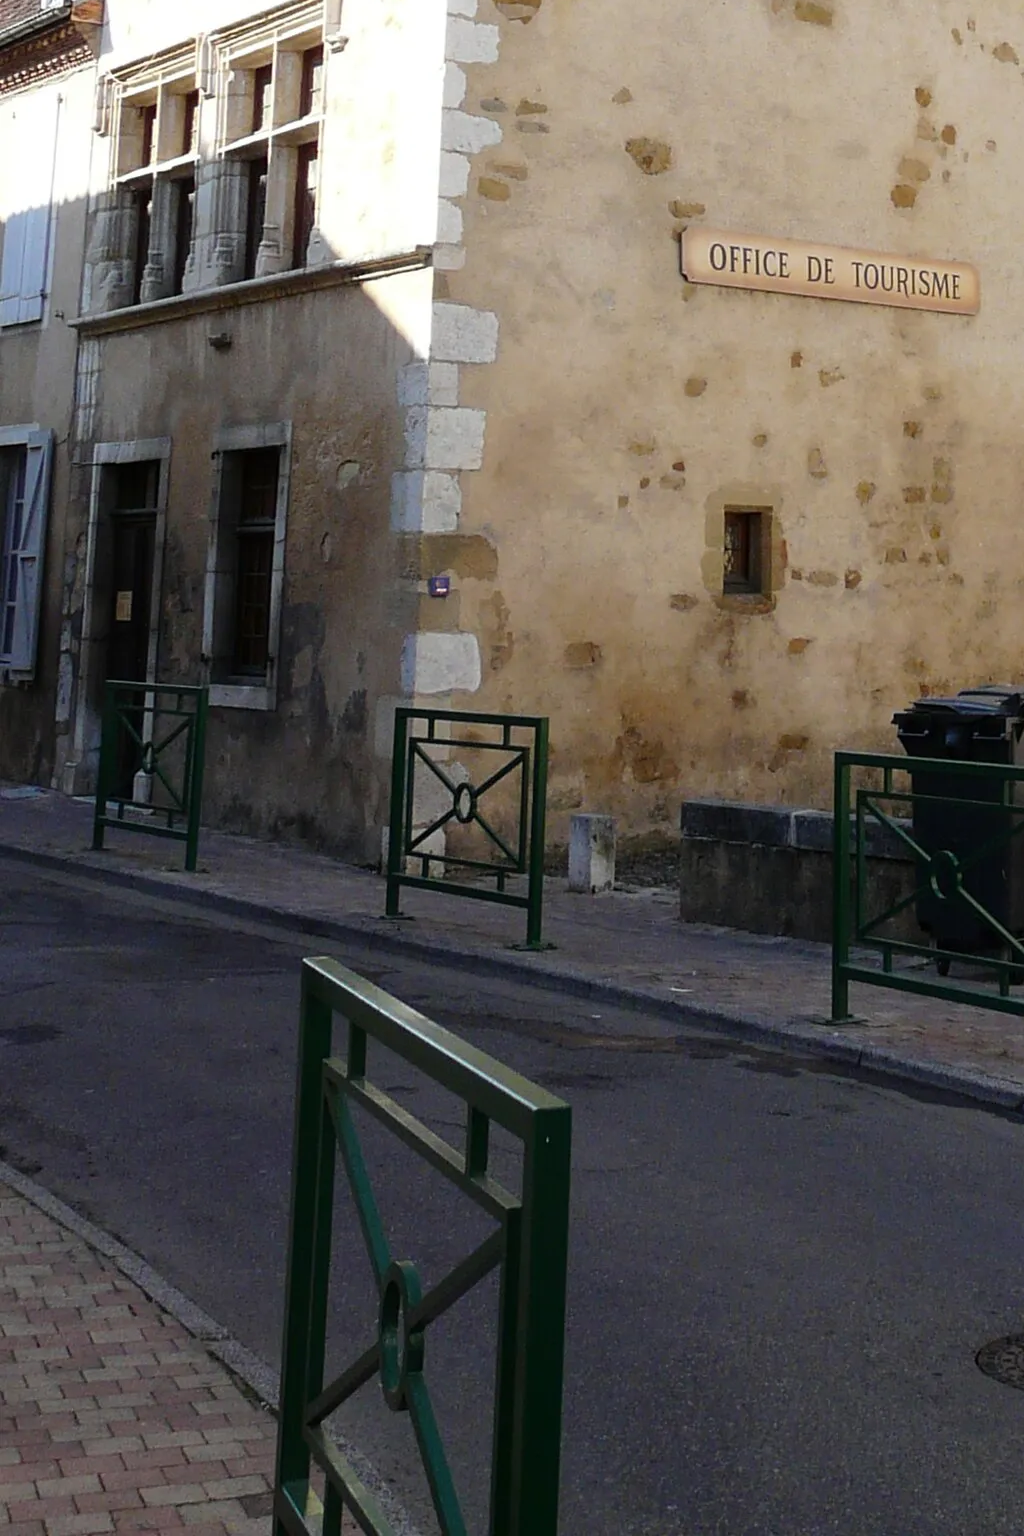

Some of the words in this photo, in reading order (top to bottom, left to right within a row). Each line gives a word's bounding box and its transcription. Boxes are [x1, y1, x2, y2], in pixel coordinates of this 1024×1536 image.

[709, 243, 791, 278] OFFICE
[807, 256, 835, 284] DE
[851, 262, 961, 300] TOURISME
